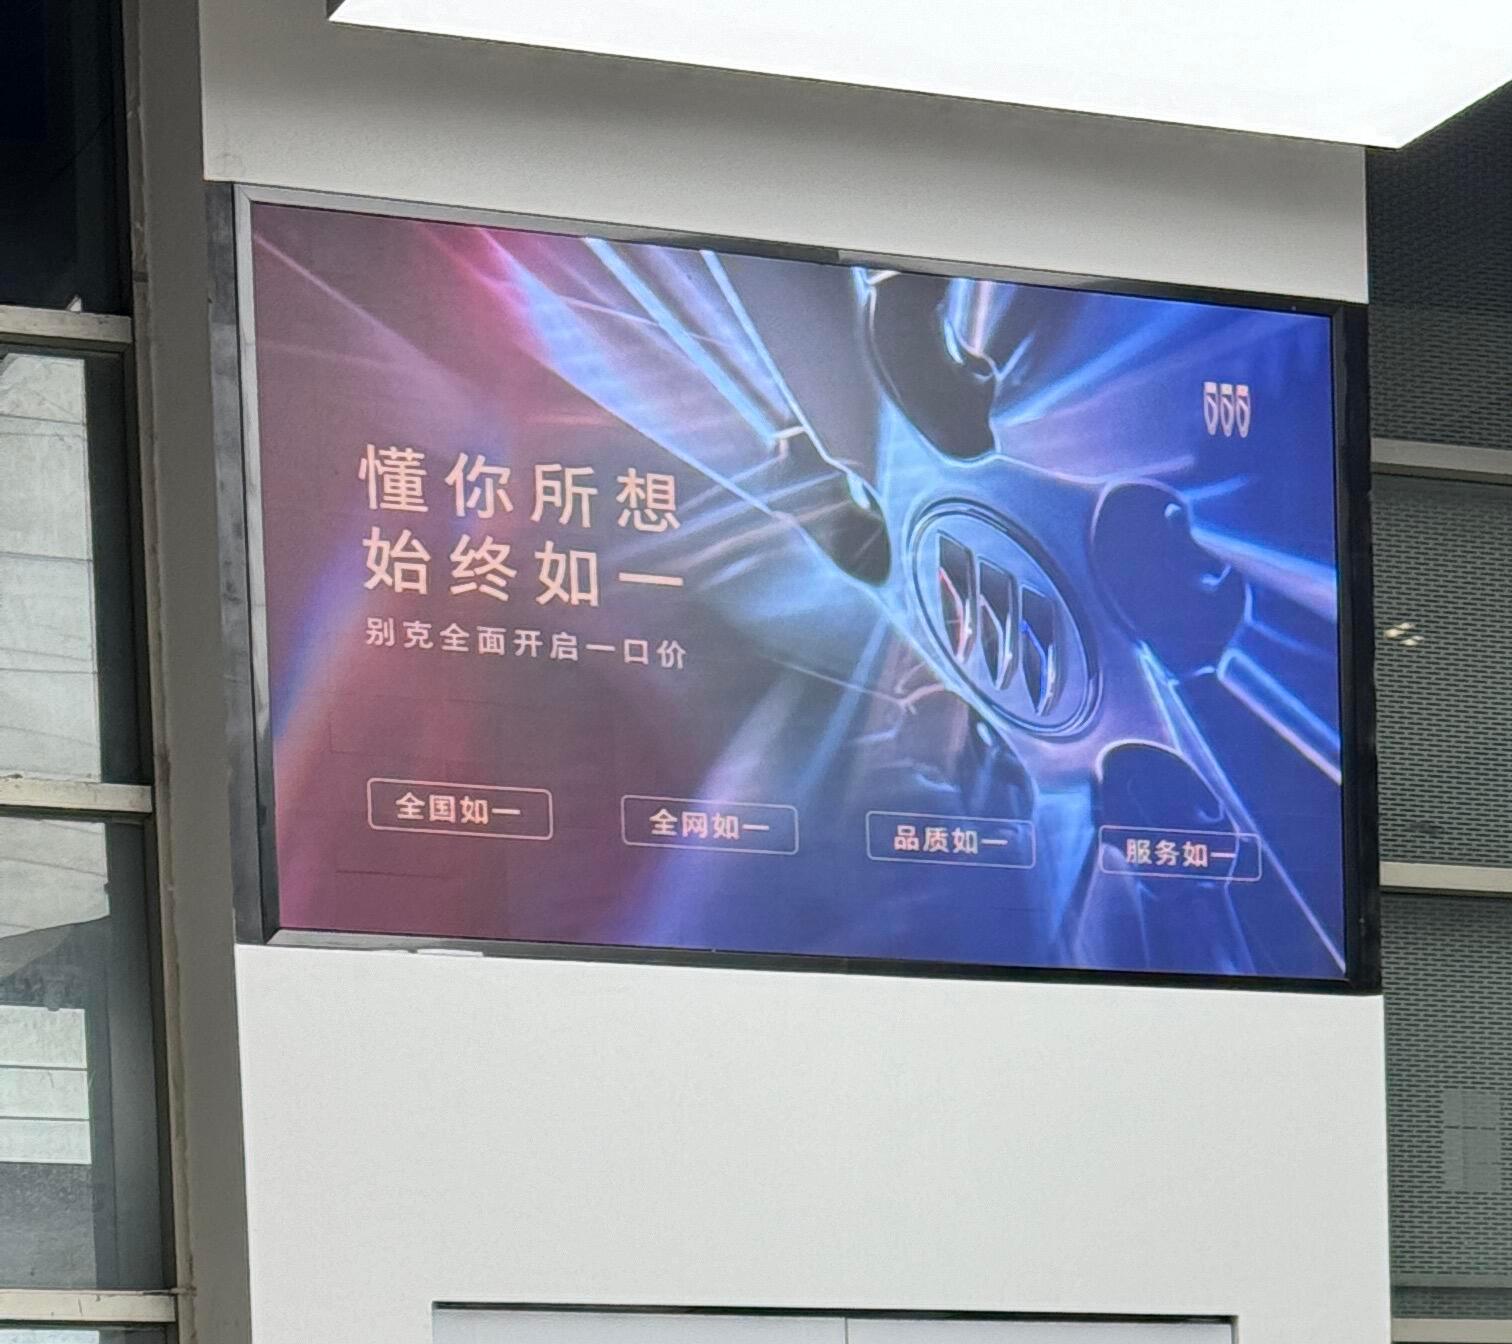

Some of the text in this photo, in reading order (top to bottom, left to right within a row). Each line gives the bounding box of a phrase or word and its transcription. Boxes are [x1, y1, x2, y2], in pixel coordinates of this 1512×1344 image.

[358, 444, 681, 533] 懂你所想
[361, 526, 684, 607] 始终如一
[365, 616, 687, 669] 别克全面开启一口价
[395, 791, 522, 826] 全国如一
[648, 807, 770, 841] 全网如一
[893, 824, 1009, 855] 品质如一
[1125, 837, 1237, 868] 服务如一
